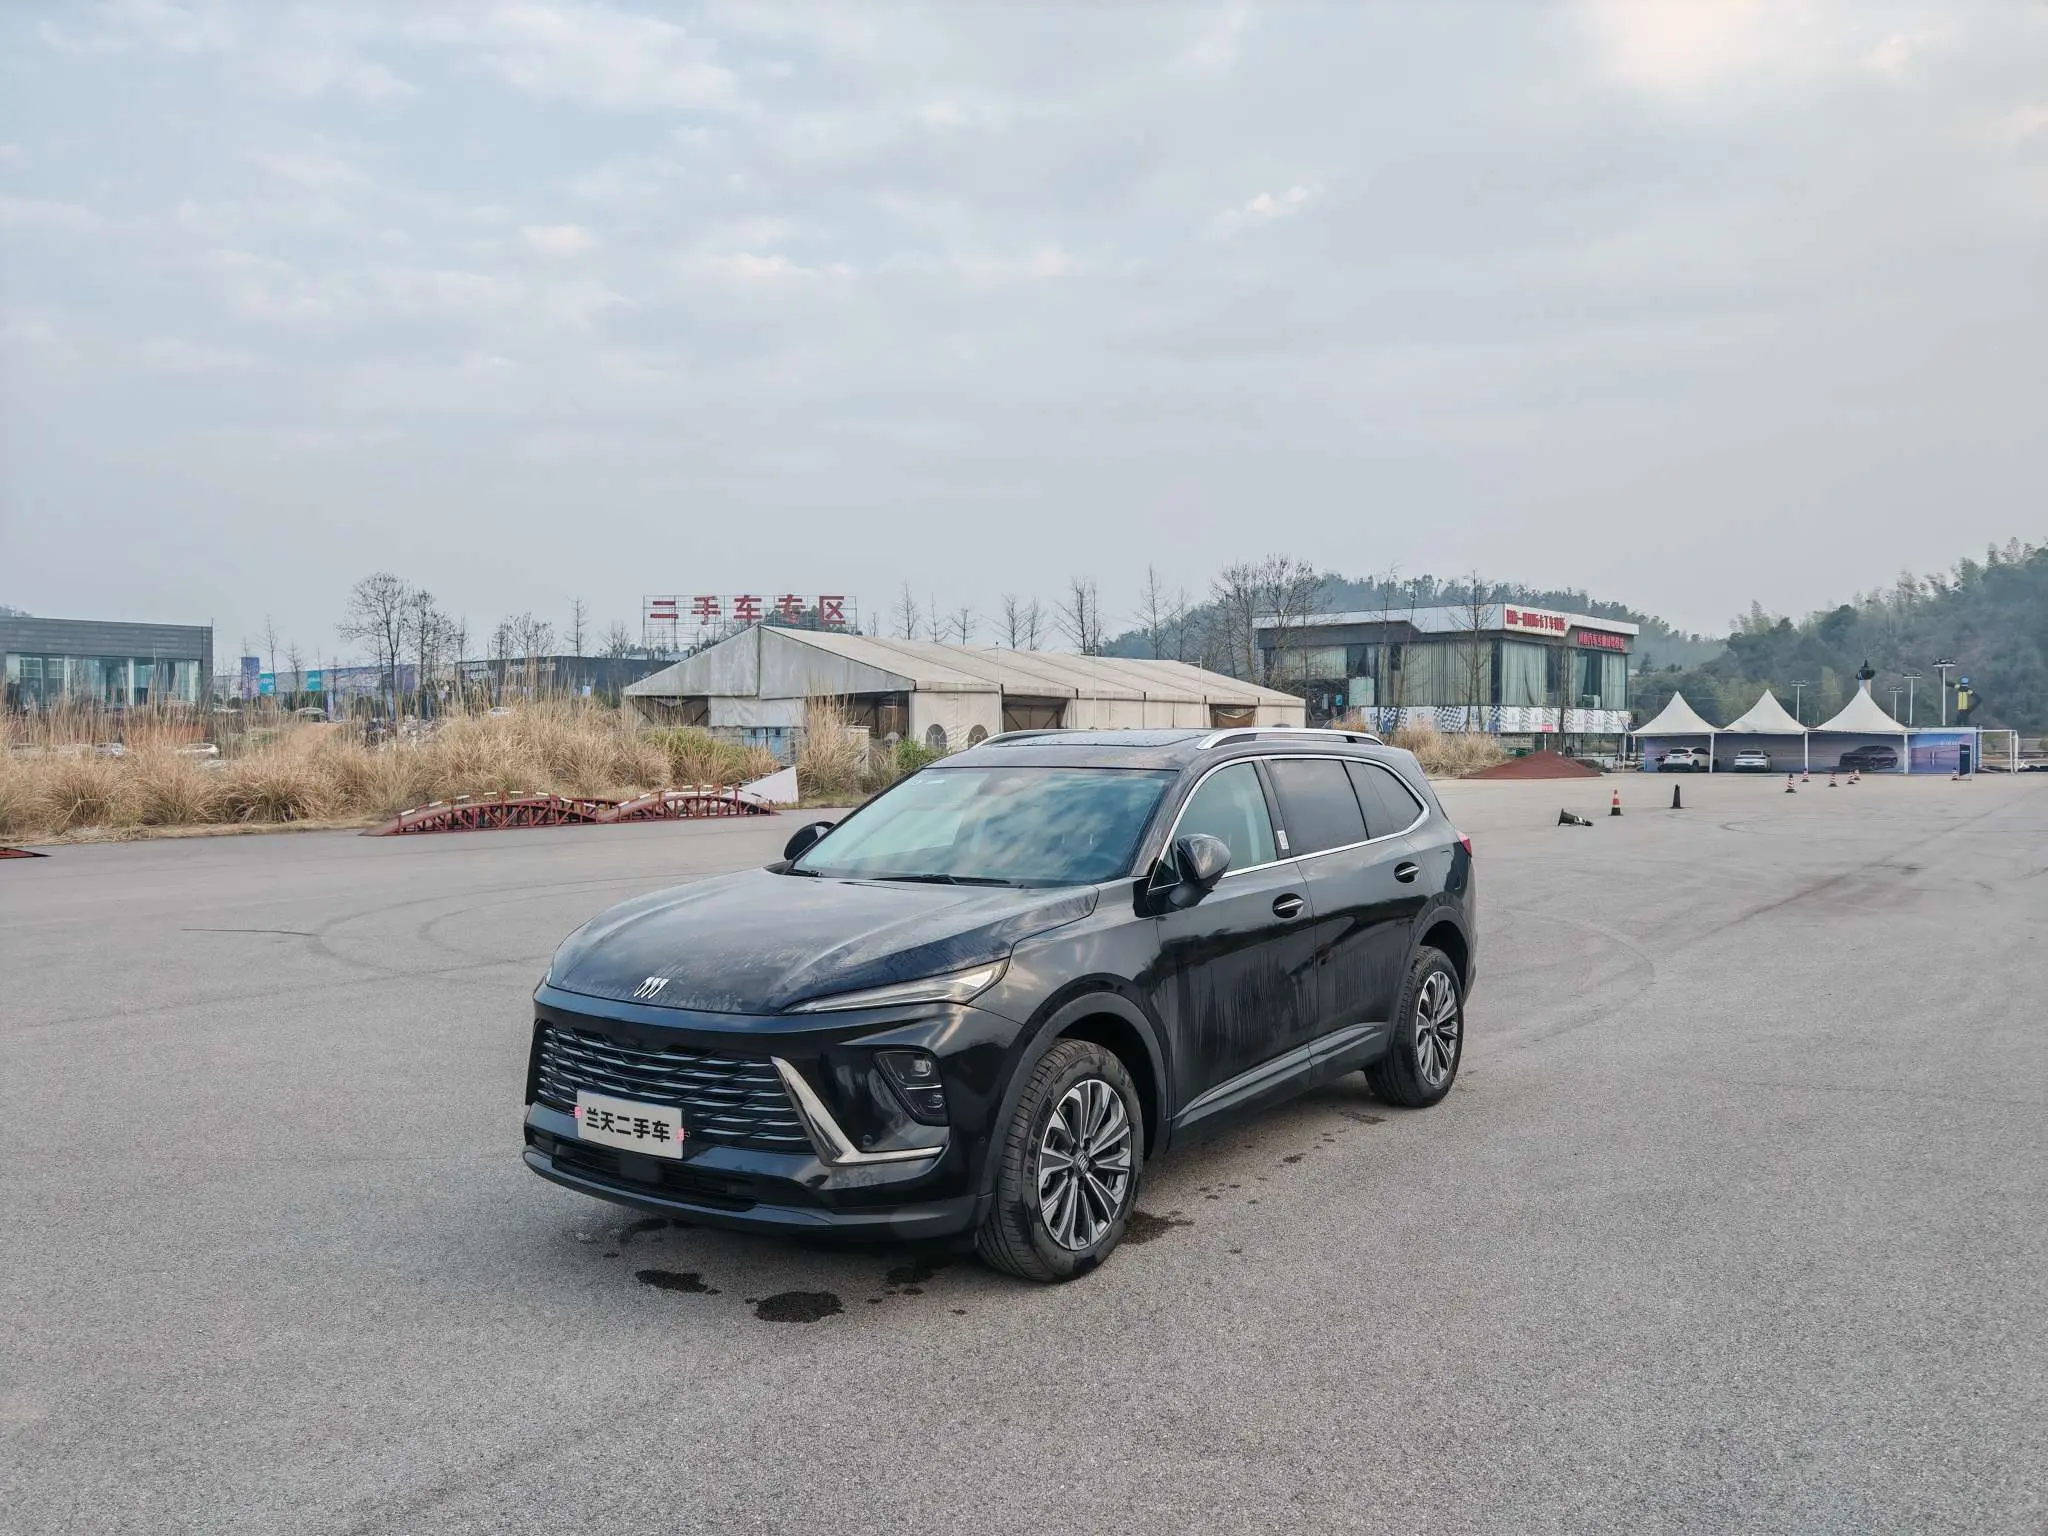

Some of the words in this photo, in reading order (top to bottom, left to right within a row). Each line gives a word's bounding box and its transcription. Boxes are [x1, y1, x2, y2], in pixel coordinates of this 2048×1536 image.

[650, 594, 847, 625] 二手车专区
[586, 1106, 670, 1142] 兰天二手车
